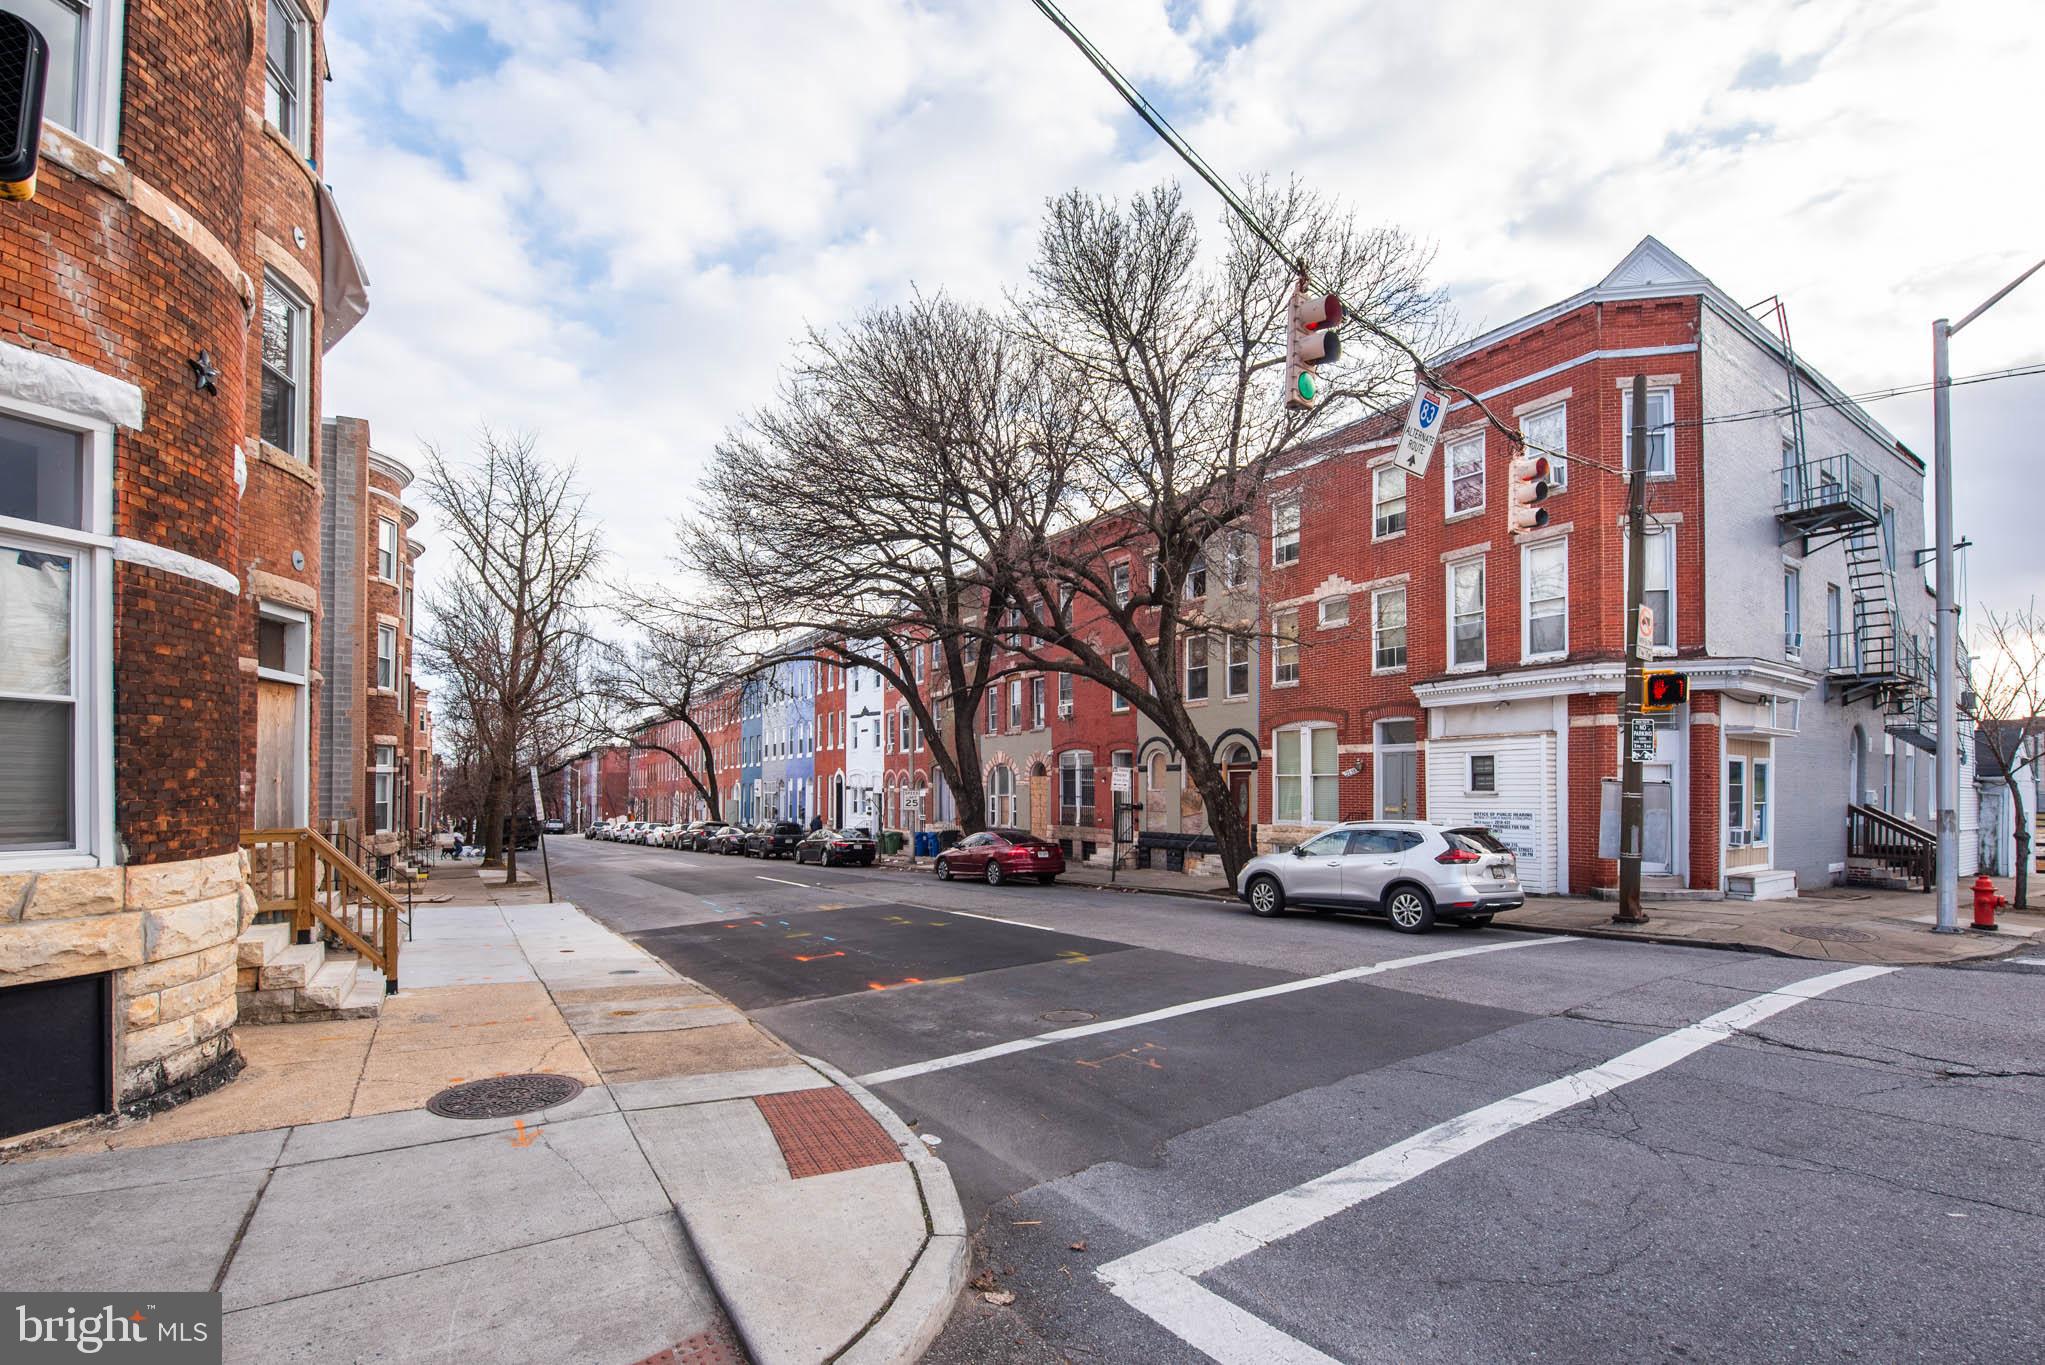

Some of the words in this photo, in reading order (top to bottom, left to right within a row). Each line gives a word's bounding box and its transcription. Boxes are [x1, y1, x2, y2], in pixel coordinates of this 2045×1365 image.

[1420, 403, 1436, 424] 83
[1406, 426, 1436, 447] ALTERNATE
[1407, 439, 1426, 455] ROUTE
[905, 799, 919, 807] 25
